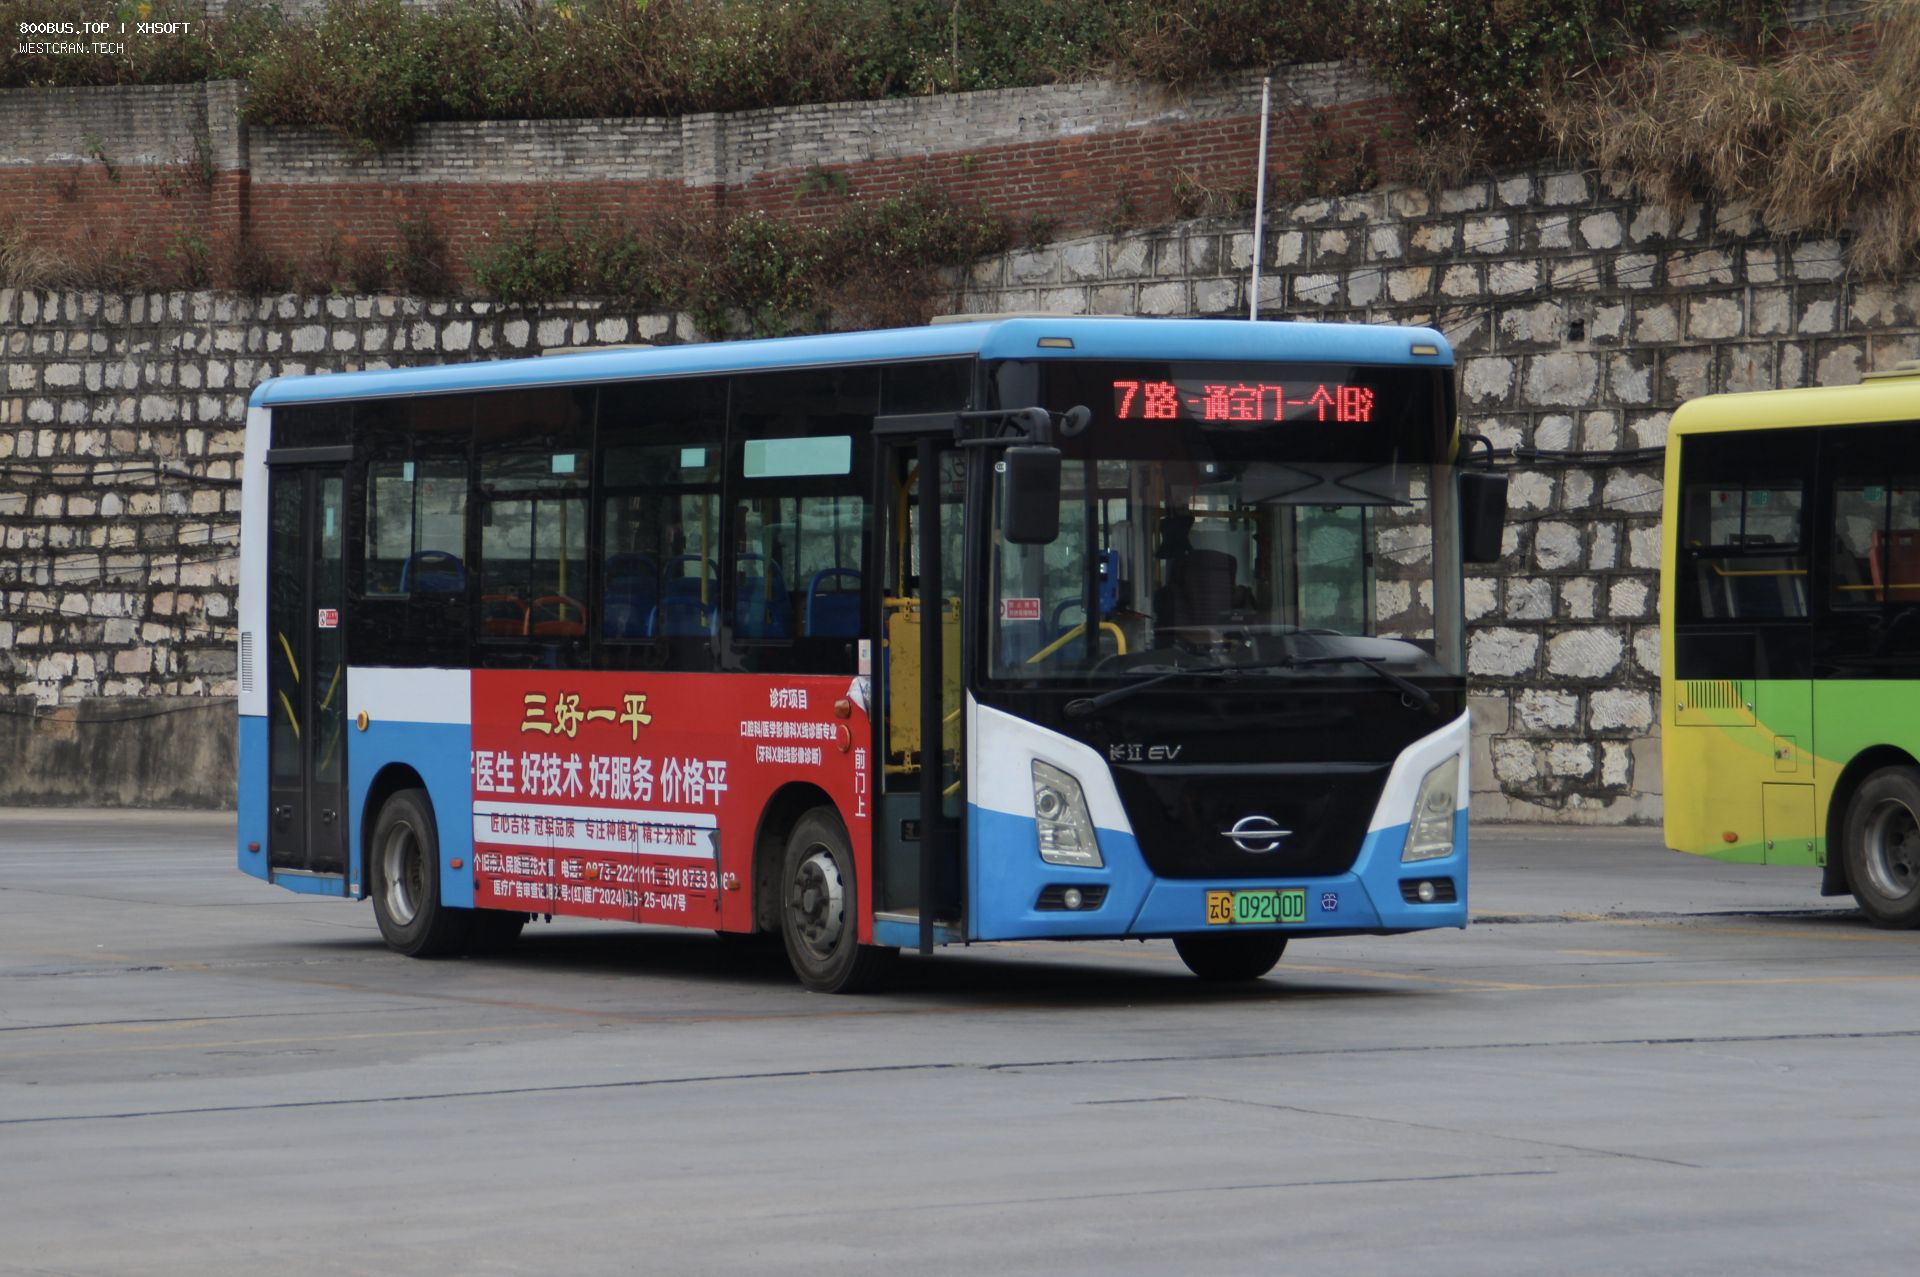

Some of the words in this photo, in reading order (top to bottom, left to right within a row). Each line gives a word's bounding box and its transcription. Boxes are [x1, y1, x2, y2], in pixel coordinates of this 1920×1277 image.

[521, 692, 652, 741] 三好一平
[769, 688, 807, 710] 诊疗项目
[1148, 745, 1181, 760] EV
[471, 750, 515, 793] 医生
[520, 752, 583, 798] 好技术
[589, 754, 654, 801] 好服务
[660, 757, 728, 806] 价格平
[855, 748, 866, 817] 前门上
